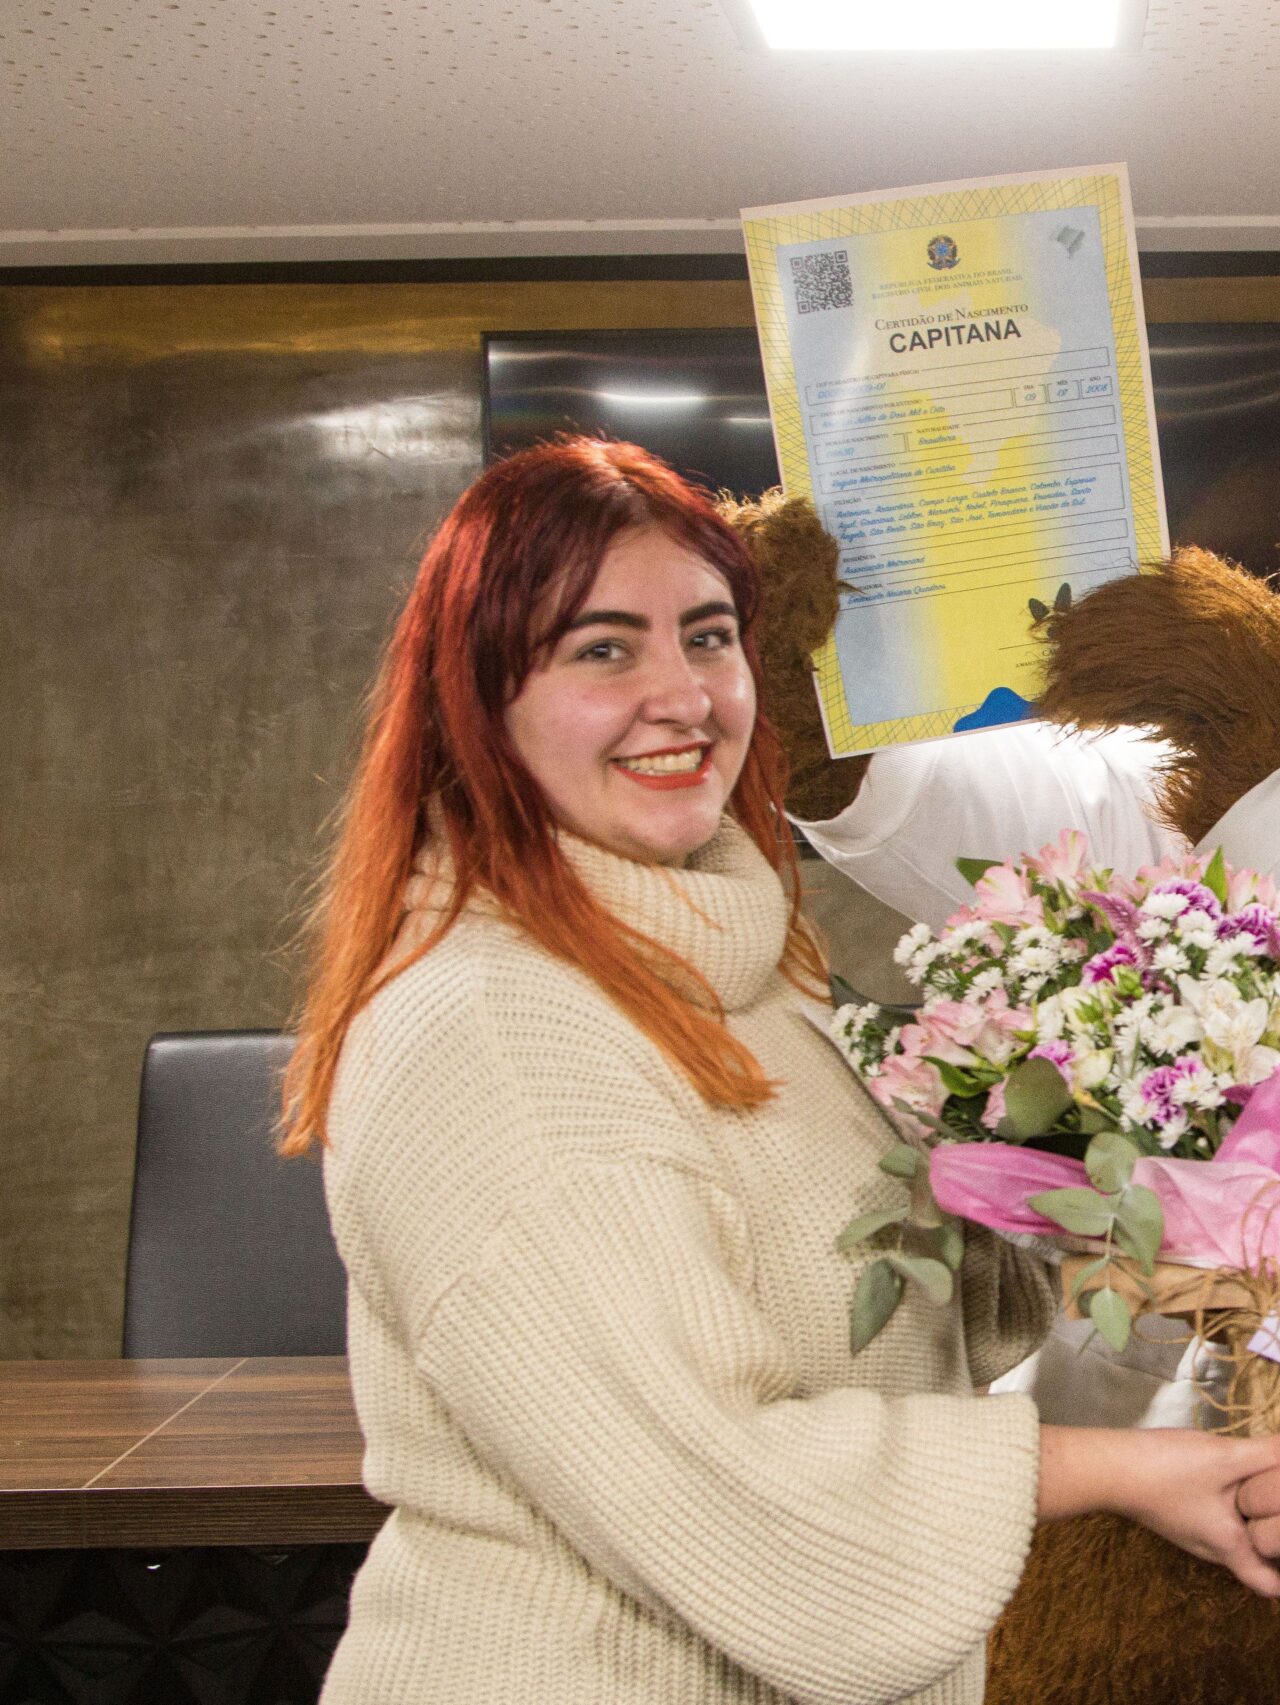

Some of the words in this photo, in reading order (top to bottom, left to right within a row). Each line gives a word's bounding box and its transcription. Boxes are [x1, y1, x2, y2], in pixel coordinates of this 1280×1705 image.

[873, 314, 935, 331] CERTIDÃO
[937, 312, 953, 323] DE
[955, 304, 1029, 320] NASCIMENTO
[889, 319, 1022, 353] CAPITANA
[859, 463, 896, 472] NASCIMENTO
